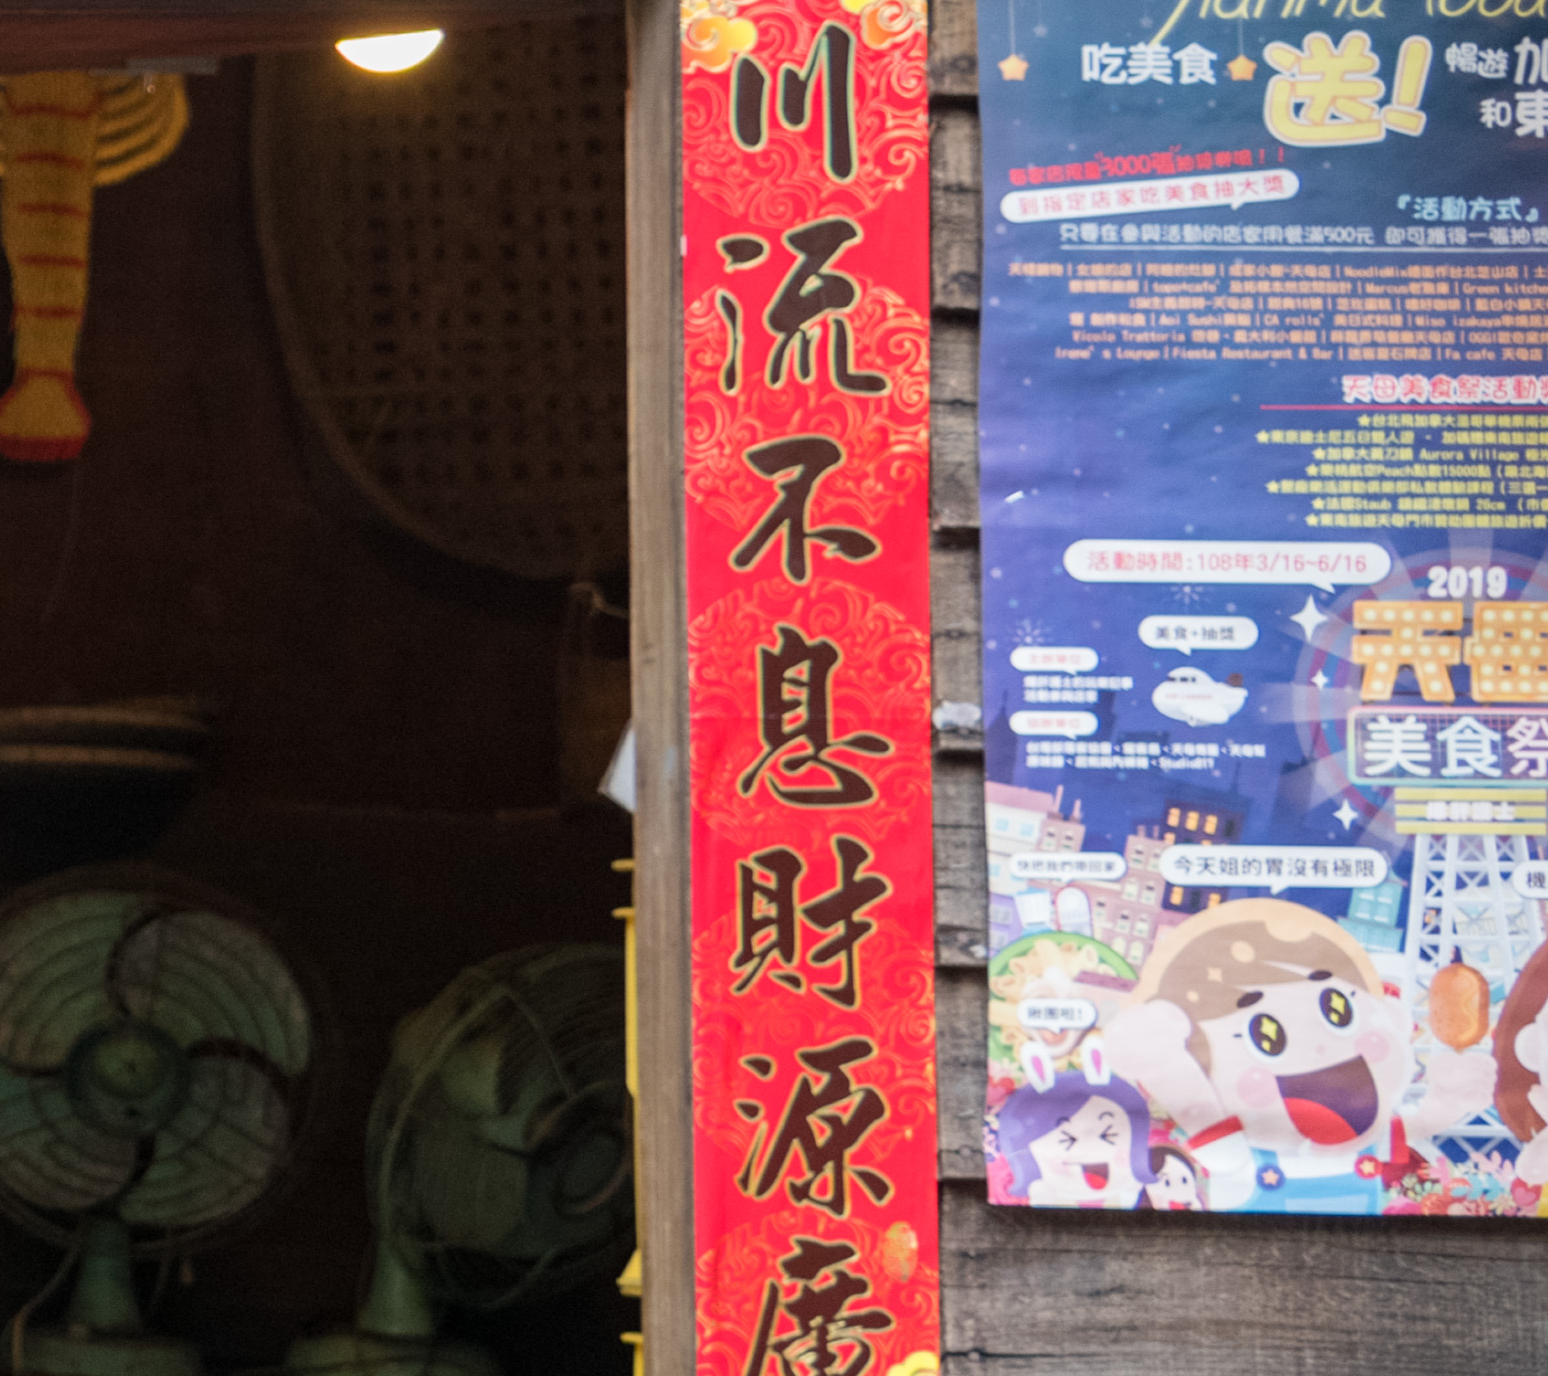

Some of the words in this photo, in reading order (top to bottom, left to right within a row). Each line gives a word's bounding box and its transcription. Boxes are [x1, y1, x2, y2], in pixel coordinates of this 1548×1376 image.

[1081, 42, 1218, 86] 吃美食
[1018, 174, 1285, 216] 到指定店家吃美食抽大獎
[1427, 566, 1507, 599] 2019
[1172, 855, 1376, 879] 今天姐的胃沒有極限
